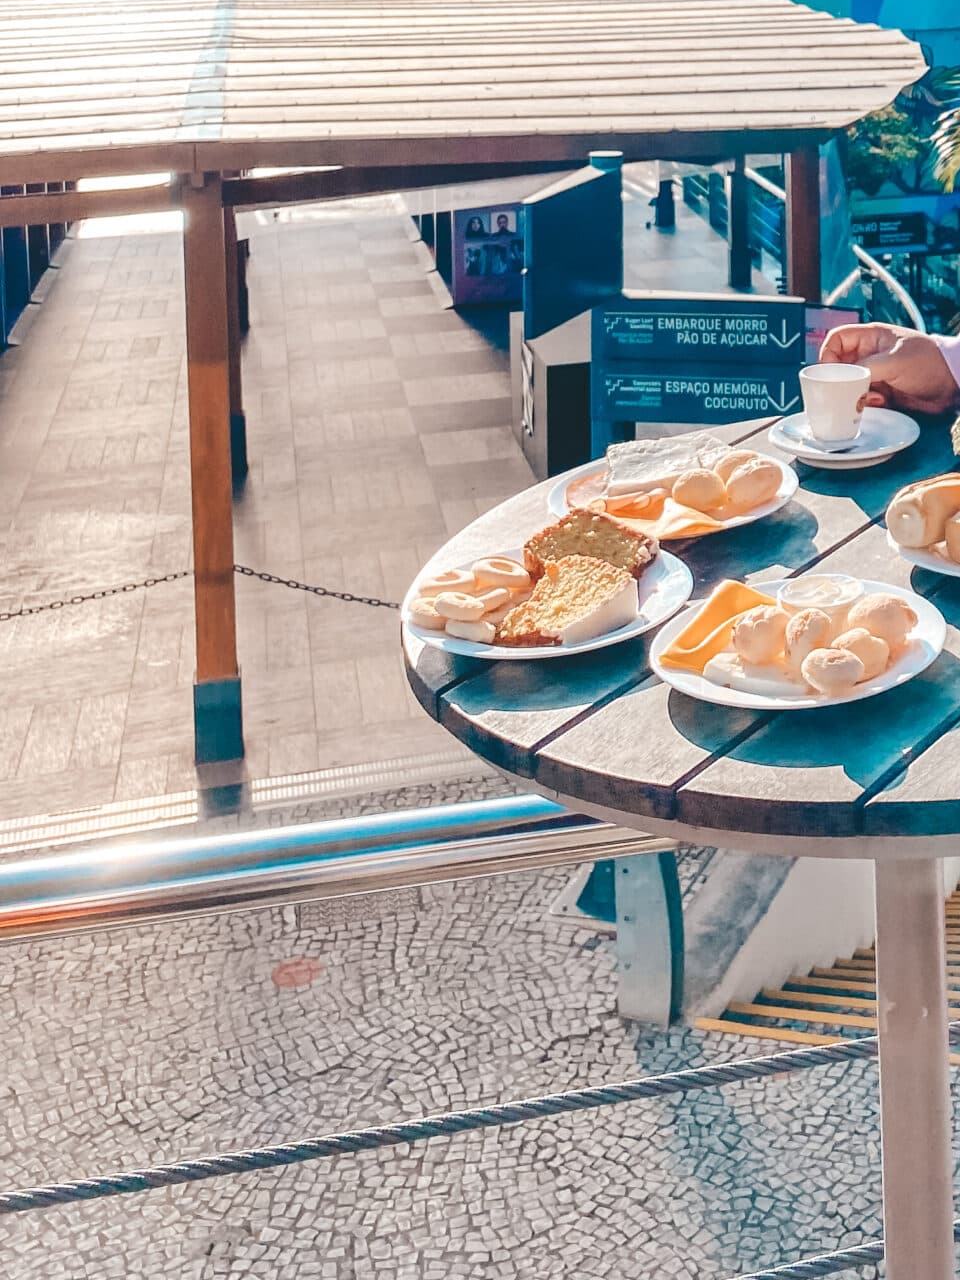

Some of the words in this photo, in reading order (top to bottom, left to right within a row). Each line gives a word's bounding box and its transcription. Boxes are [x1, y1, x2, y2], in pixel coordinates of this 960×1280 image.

[657, 317, 721, 331] EMBARQUE
[725, 319, 768, 331] MORRO
[677, 330, 699, 344] PÃO
[702, 332, 717, 345] DE
[720, 330, 768, 347] AÇÚCAR
[665, 381, 710, 397] ESPAÇO
[713, 381, 768, 395] MEMÓRIA
[704, 396, 769, 411] COCURUTO
